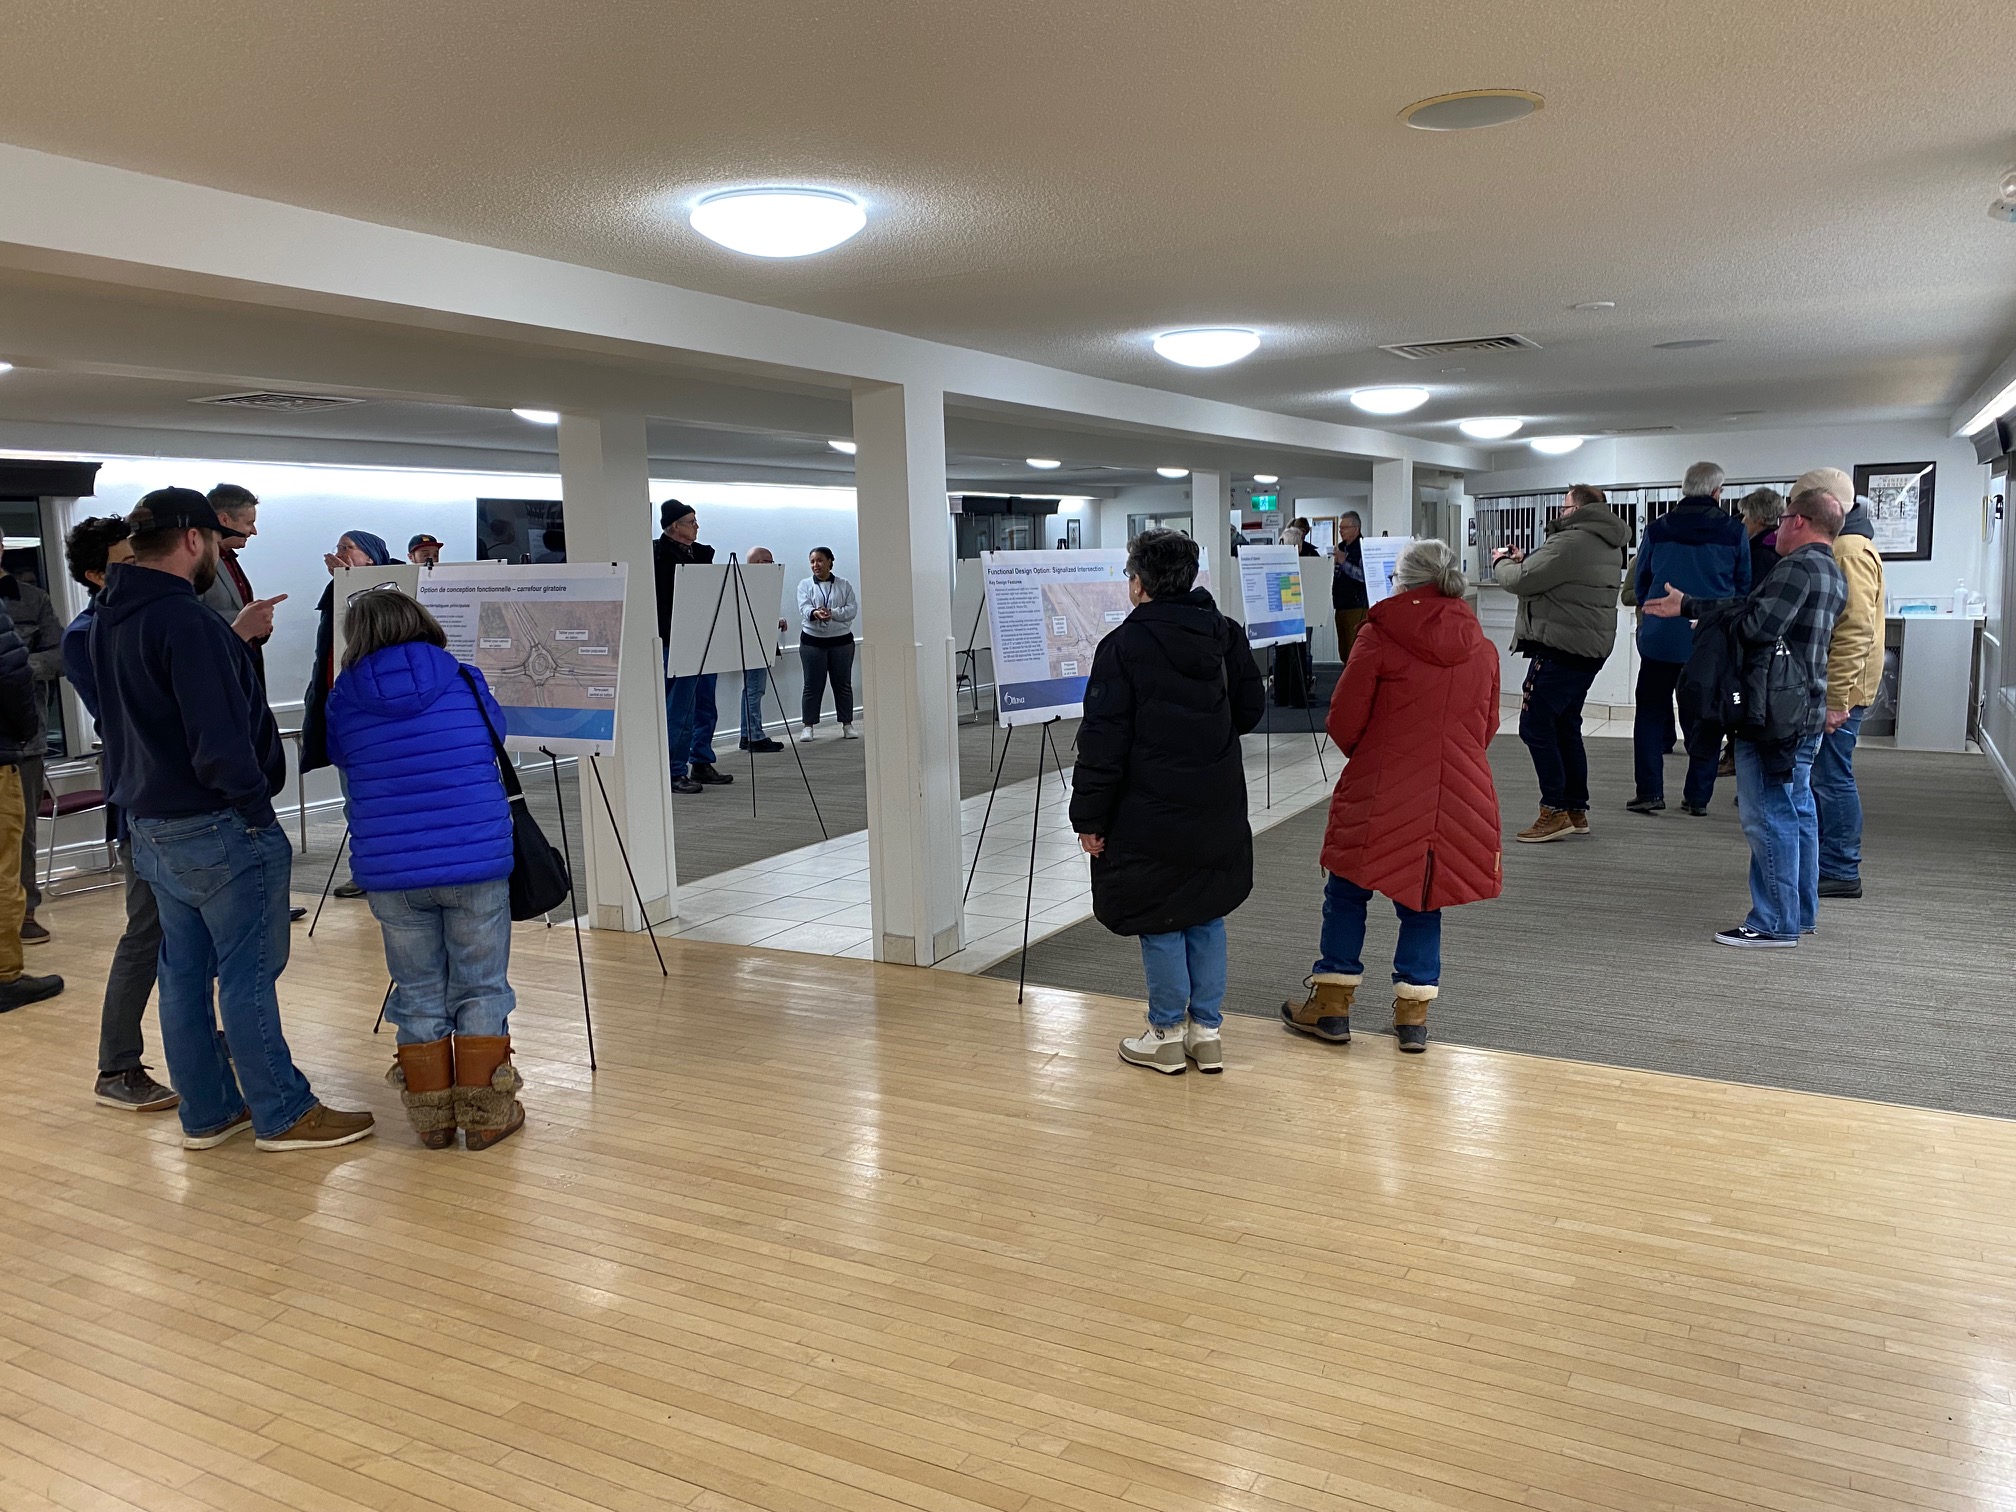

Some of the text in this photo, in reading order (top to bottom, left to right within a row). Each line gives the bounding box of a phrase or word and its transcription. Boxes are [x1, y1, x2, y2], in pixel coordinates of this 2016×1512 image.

[988, 567, 1014, 575] Functional
[1015, 567, 1032, 576] Design
[1033, 567, 1051, 575] Option:
[1052, 566, 1077, 575] Signalized
[420, 586, 438, 594] Option
[447, 586, 476, 594] conception
[477, 585, 511, 593] fonctionnelle
[543, 585, 567, 593] giratoire
